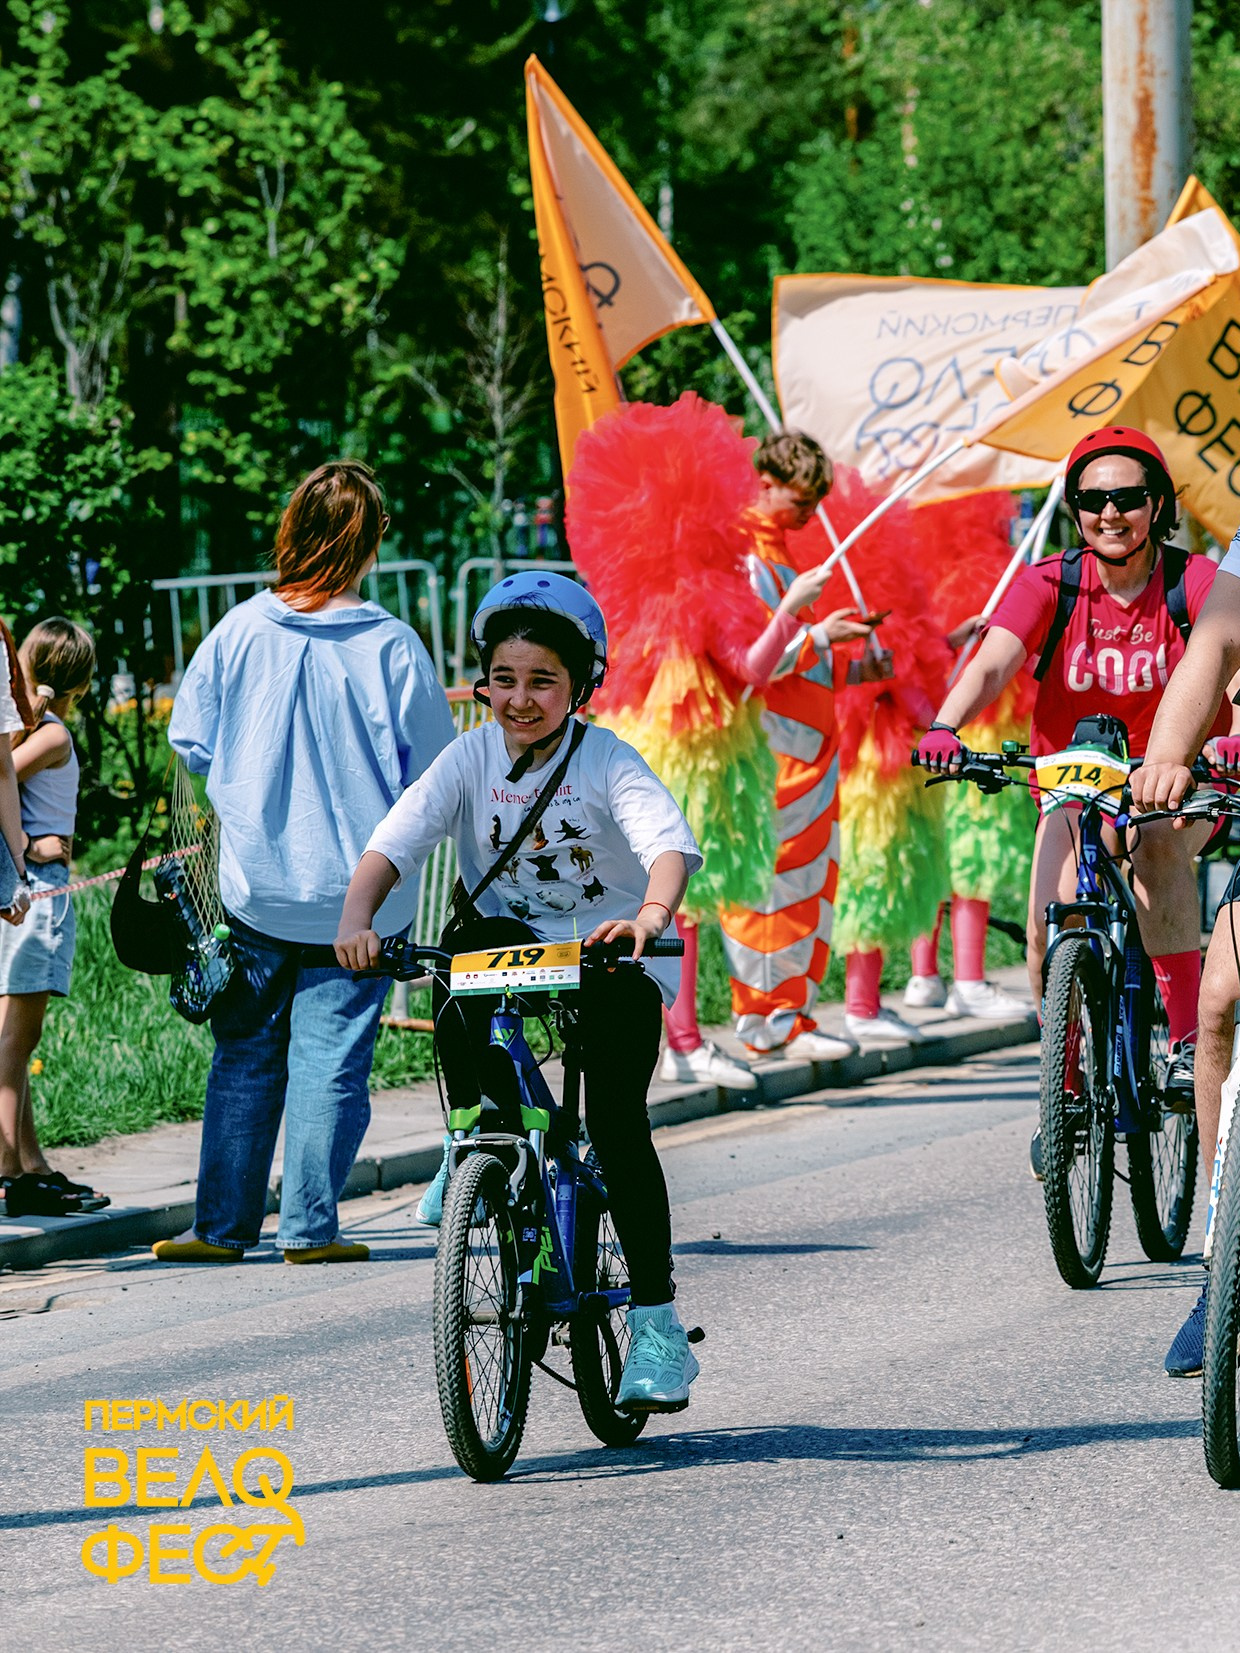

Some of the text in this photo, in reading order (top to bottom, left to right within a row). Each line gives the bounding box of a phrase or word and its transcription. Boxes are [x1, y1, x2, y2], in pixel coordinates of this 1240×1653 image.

[1130, 623, 1154, 645] Be
[1057, 765, 1102, 786] 714
[486, 947, 545, 968] 719
